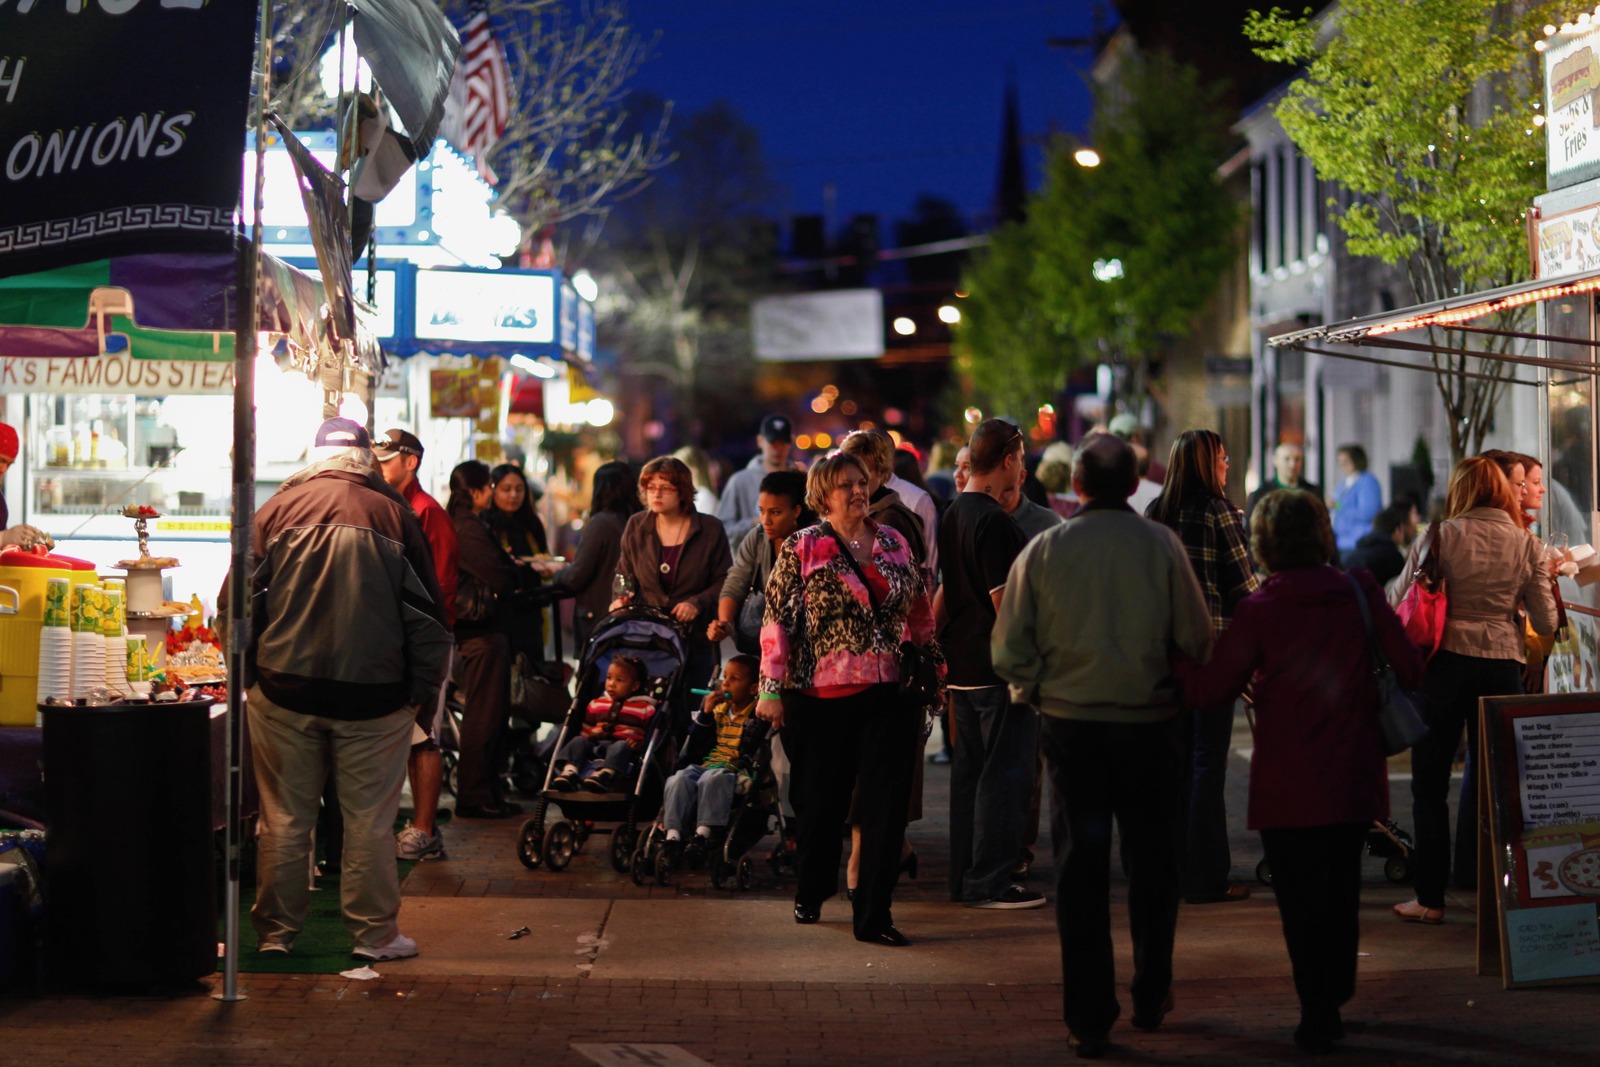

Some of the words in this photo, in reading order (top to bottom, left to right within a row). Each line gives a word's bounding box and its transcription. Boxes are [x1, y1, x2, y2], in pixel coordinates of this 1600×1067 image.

[5, 111, 196, 181] ONIONS
[1564, 127, 1587, 162] Fries
[46, 357, 161, 388] FAMOUS
[1536, 723, 1552, 731] Dog
[1522, 733, 1563, 741] Hamburger
[1524, 752, 1555, 760] Meatball
[1556, 751, 1571, 759] Sub
[1550, 761, 1581, 769] Sausage
[1526, 783, 1549, 791] Wings
[1550, 782, 1563, 790] (6)
[1549, 801, 1569, 810] (can)
[1529, 812, 1551, 820] Water
[1553, 810, 1581, 819] (bottle)
